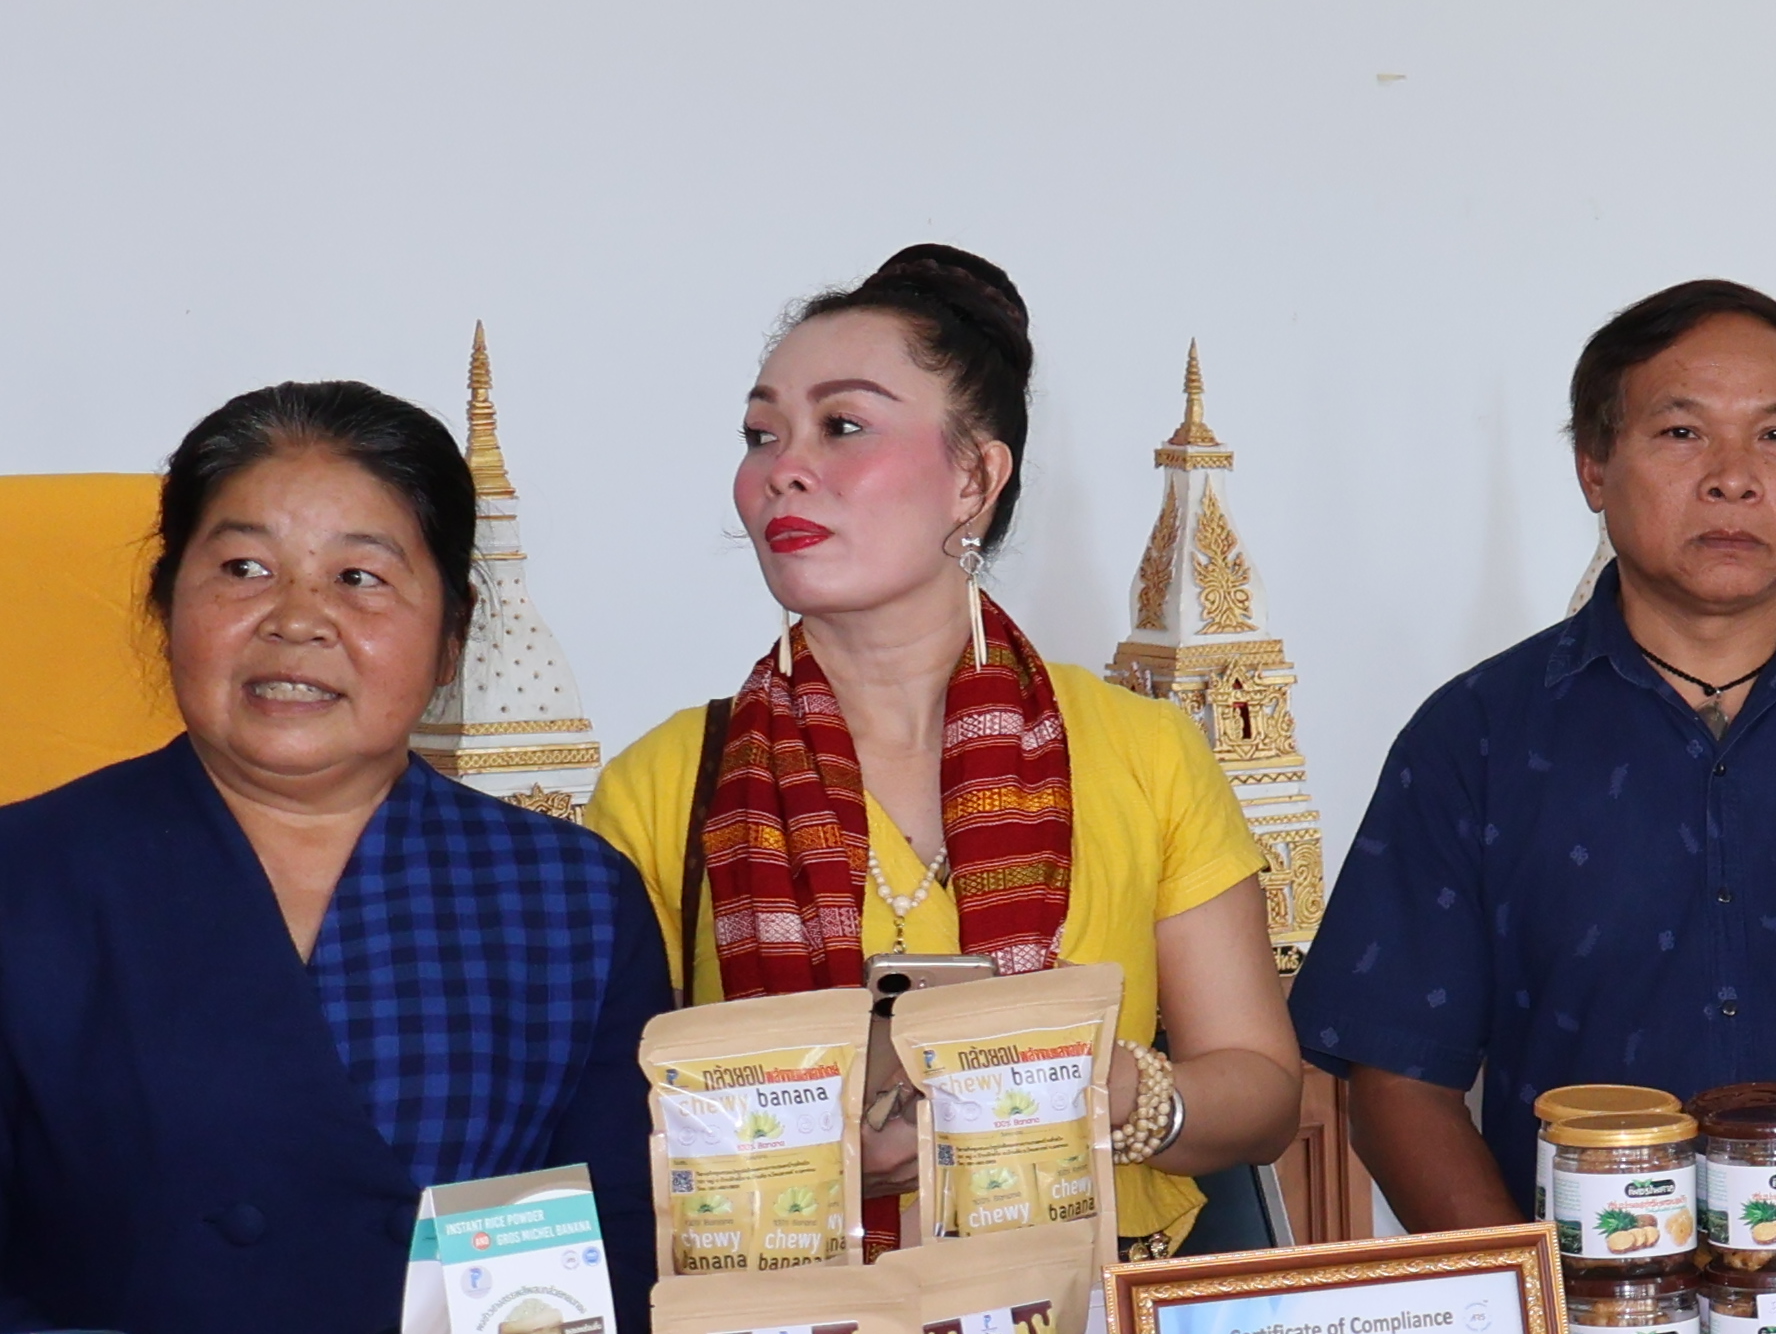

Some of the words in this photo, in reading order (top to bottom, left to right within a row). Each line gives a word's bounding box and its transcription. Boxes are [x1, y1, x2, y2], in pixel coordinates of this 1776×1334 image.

[958, 1045, 1020, 1071] กล้วยอบ
[703, 1063, 765, 1091] กล้วยอบ
[939, 1071, 1003, 1095] chewy
[1011, 1063, 1083, 1086] banana
[678, 1091, 751, 1117] chewy
[756, 1084, 829, 1108] banana
[1052, 1176, 1093, 1200] chewy
[445, 1219, 484, 1236] INSTANT
[485, 1215, 506, 1230] RICE
[507, 1209, 546, 1227] POWDER
[968, 1202, 1031, 1229] chewy
[1049, 1196, 1096, 1222] banana
[496, 1231, 521, 1247] GROS
[557, 1219, 592, 1237] BANANA
[680, 1230, 742, 1254] chewy
[764, 1229, 822, 1255] chewy
